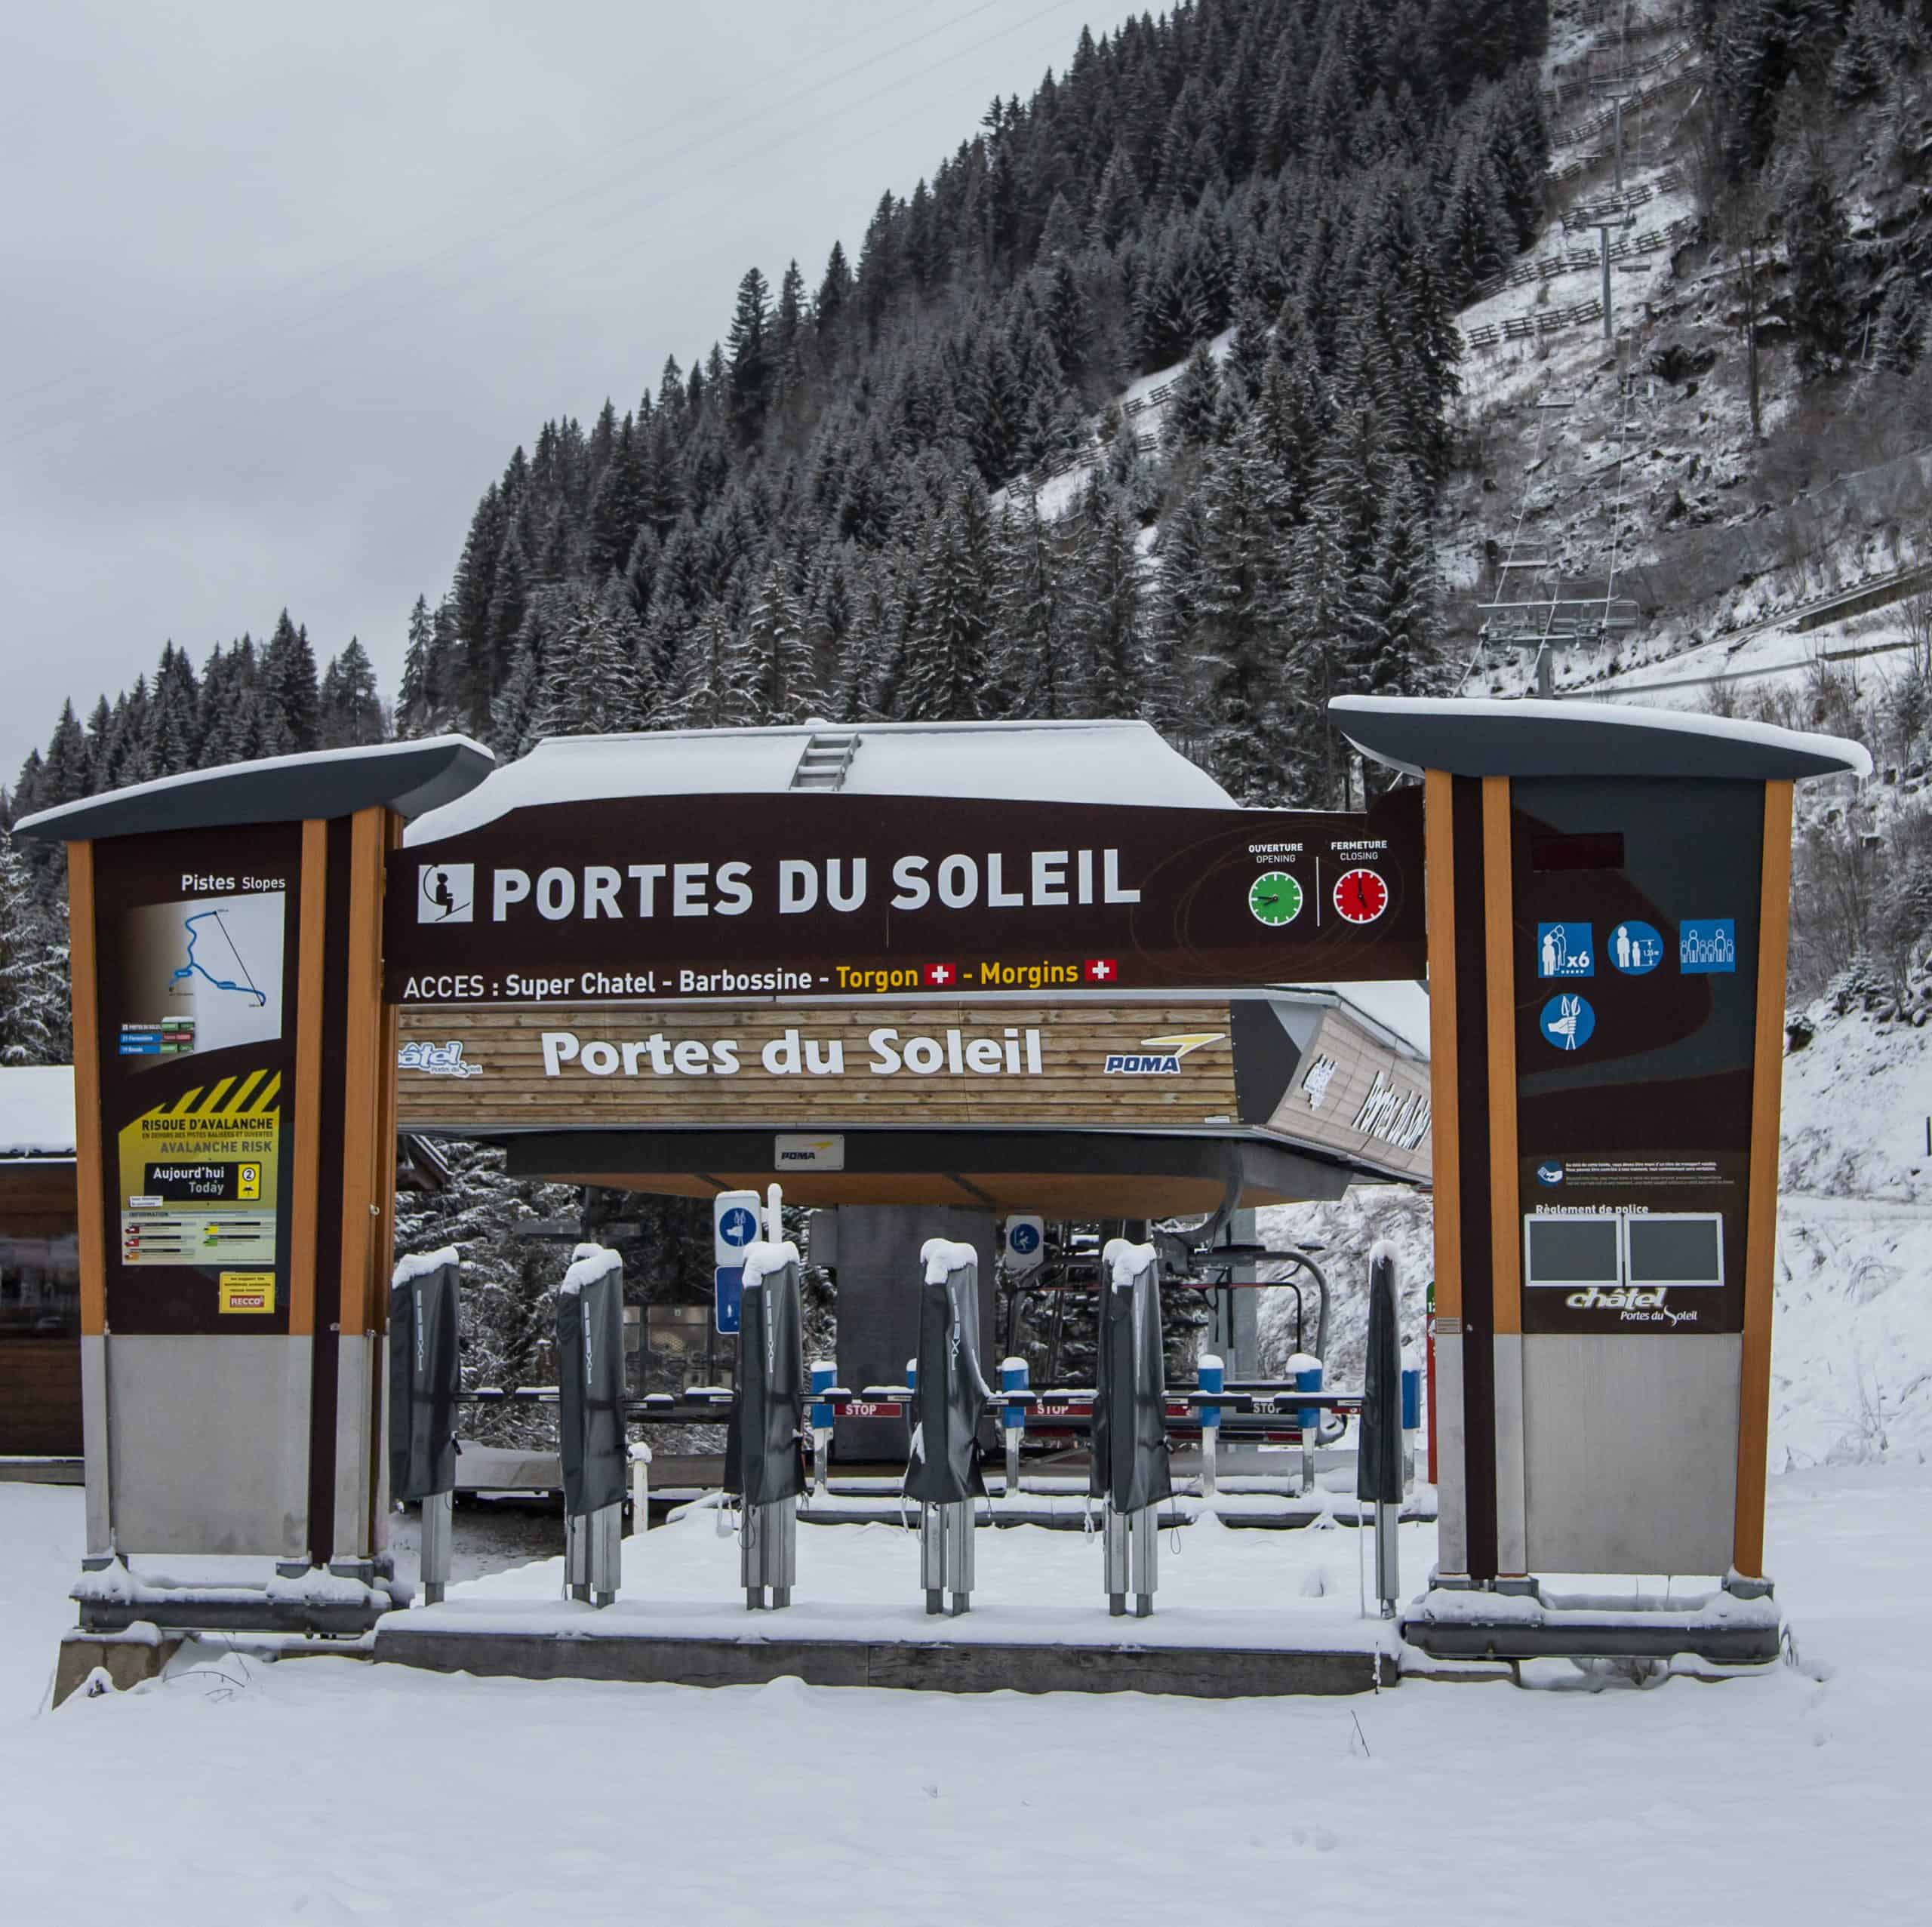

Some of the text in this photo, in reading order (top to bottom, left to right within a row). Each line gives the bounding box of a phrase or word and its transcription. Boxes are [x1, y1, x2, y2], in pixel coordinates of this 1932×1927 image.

[1248, 843, 1303, 853] OUVERTURE
[1331, 840, 1388, 850] FERMETURE
[1257, 854, 1296, 863] OPENING
[1340, 852, 1379, 861] CLOSING
[181, 874, 285, 892] Pistes Slopes
[493, 849, 1141, 922] PORTES DU SOLEIL
[1567, 951, 1589, 968] x6
[403, 975, 484, 998] ACCES
[506, 973, 574, 1000] Super
[581, 971, 656, 994] Chatel
[679, 968, 812, 993] Barbossine
[836, 966, 918, 992] Torgon
[981, 960, 1078, 989] Morgins
[398, 1043, 462, 1069] âtel
[541, 1028, 1043, 1076] Portes du Soleil
[1106, 1056, 1180, 1073] POMA
[142, 1117, 273, 1131] RISQUE D'AVALANCHE
[160, 1140, 272, 1153] AVALANCHE RISK
[780, 1151, 816, 1160] POMA
[153, 1166, 253, 1181] Aujourd'hui 2
[189, 1181, 224, 1195] Today
[1599, 1204, 1613, 1213] de
[1615, 1203, 1649, 1213] police
[1620, 1311, 1650, 1320] Portes
[1651, 1311, 1664, 1320] du
[845, 1404, 877, 1415] STOP
[1037, 1403, 1069, 1415] STOP
